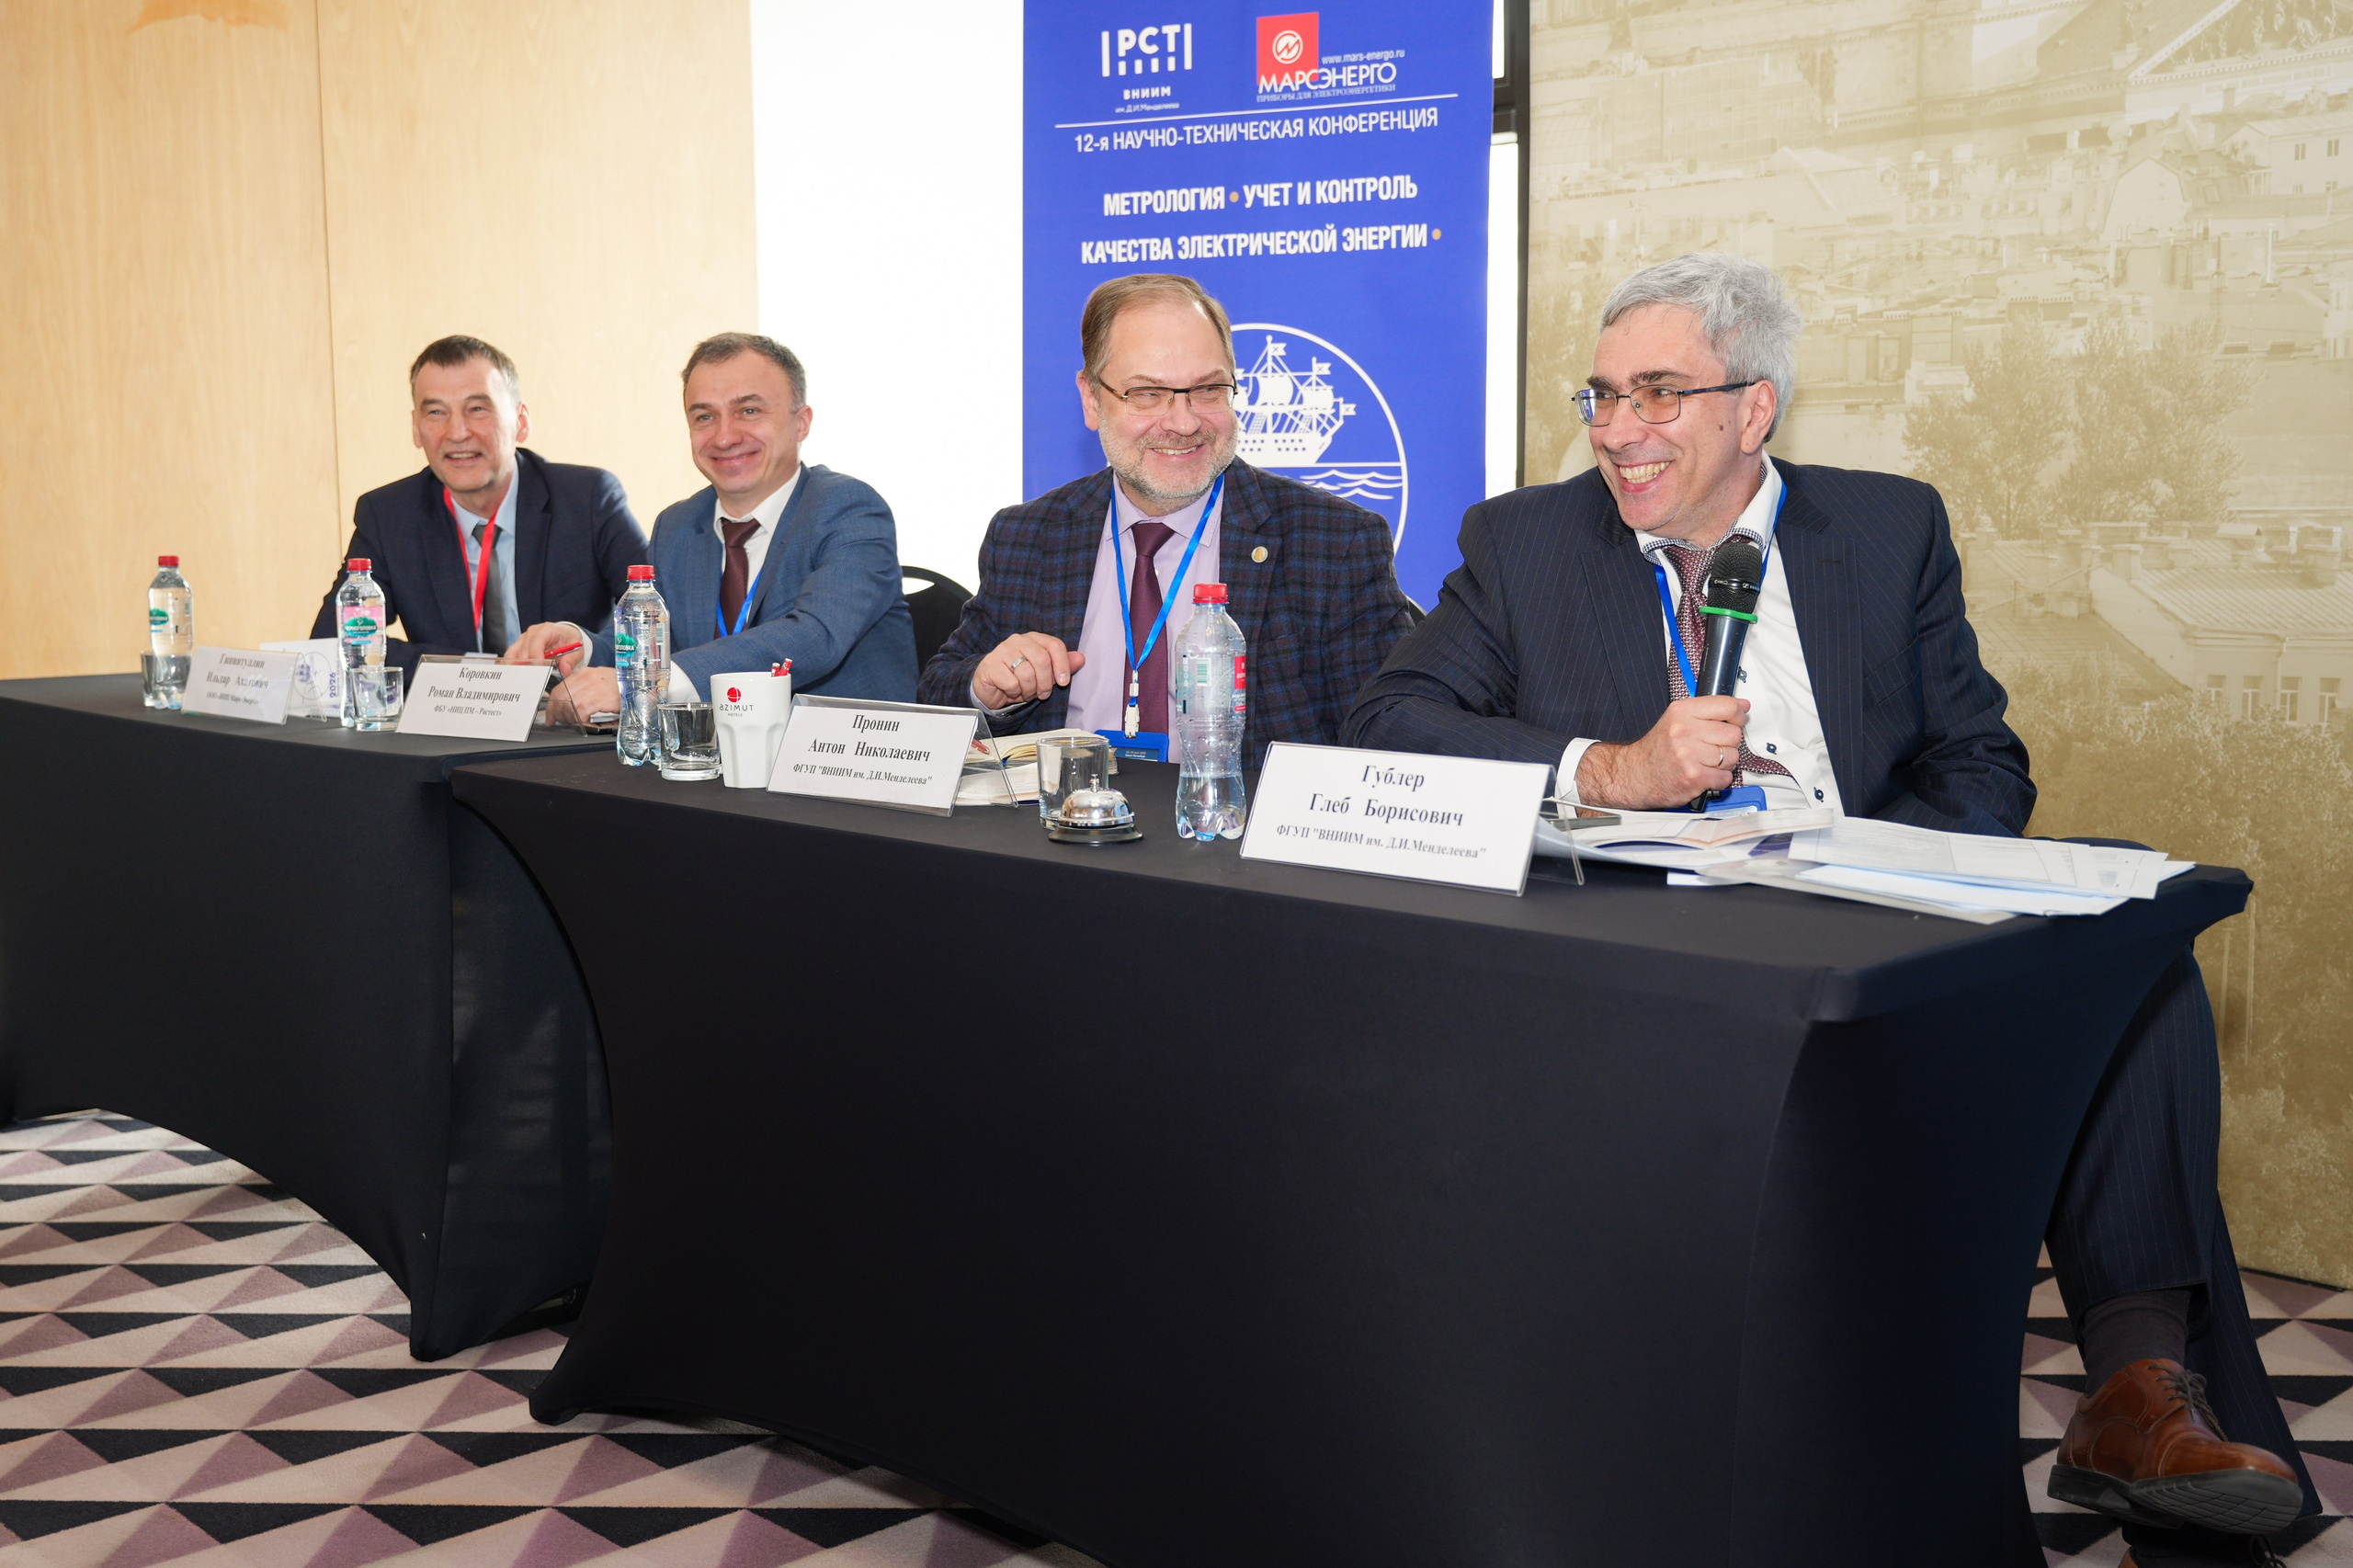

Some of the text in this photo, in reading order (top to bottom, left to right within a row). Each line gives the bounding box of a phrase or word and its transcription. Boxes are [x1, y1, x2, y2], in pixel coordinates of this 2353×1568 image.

[1321, 50, 1405, 65] www.mars-energo.ru
[1257, 62, 1397, 94] МАРСЭНЕРГО
[1123, 85, 1171, 100] ВНИИМ
[1256, 84, 1396, 102] ПРИБОРЫ ДЛЯ ЭЛЕКТРОЭНЕРГЕТИКИ
[1074, 107, 1438, 153] 12-я НАУЧНО-ТЕХНИЧЕСКАЯ КОНФЕРЕНЦИЯ
[1103, 174, 1418, 217] МЕТРОЛОГИЯ УЧЕТ И КОНТРОЛЬ
[1081, 222, 1428, 265] КАЧЕСТВА ЭЛЕКТРИЧЕСКОЙ ЭНЕРГИИ
[206, 672, 231, 687] Ильдар
[459, 666, 503, 681] Коровкин
[427, 686, 521, 704] Роман Владимирович
[447, 705, 463, 715] «НИЦ
[479, 708, 502, 716] Ростест»
[852, 714, 900, 733] Пронин
[808, 738, 931, 761] Антон Николаевич
[793, 763, 933, 785] ФГУП "ВНИИМ им. Д.И.Менделеева"
[1361, 765, 1425, 792] Гублер
[1309, 792, 1464, 826] Глеб Борисович
[1277, 824, 1487, 858] ФГУП "ВНИИМ им. Д.И.Менделеева"
